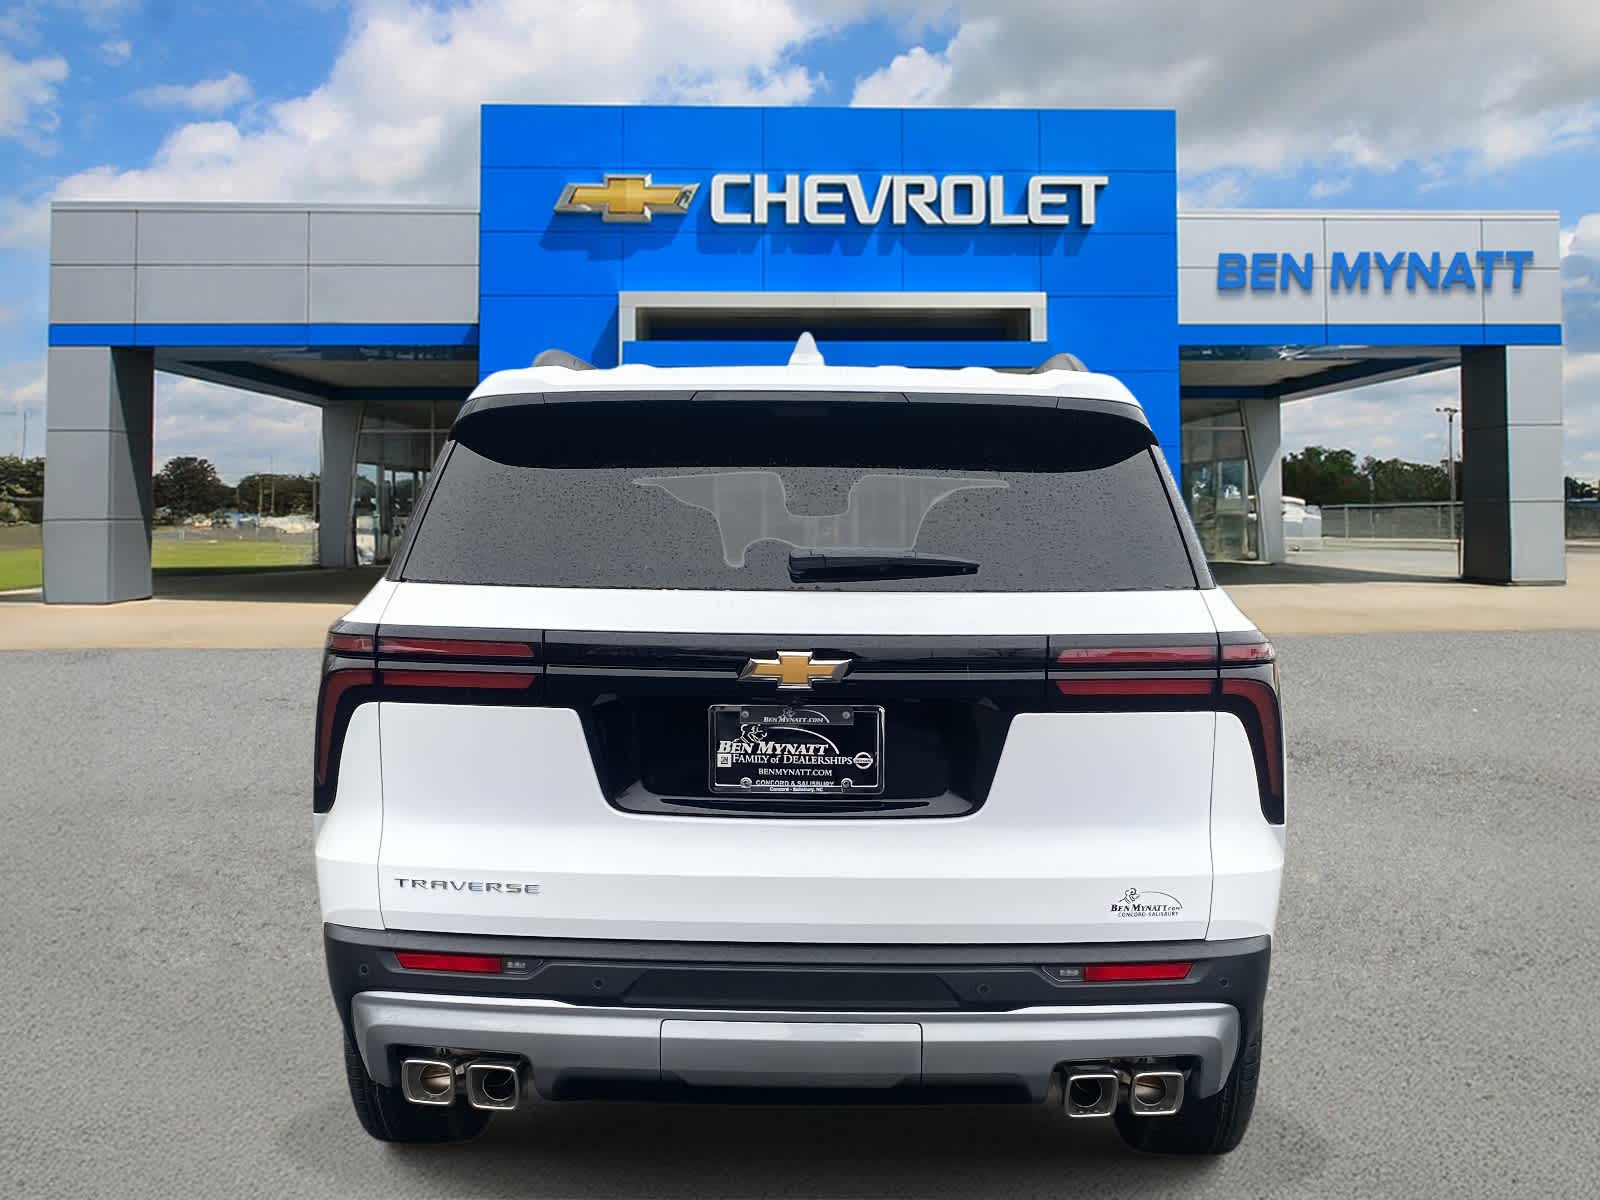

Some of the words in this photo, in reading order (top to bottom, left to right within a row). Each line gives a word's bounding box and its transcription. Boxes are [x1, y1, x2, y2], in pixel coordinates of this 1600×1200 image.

[710, 173, 1109, 225] CHEVROLET
[1217, 252, 1313, 290] BEN
[1330, 250, 1534, 290] MYNATT
[717, 740, 755, 754] BEN
[757, 741, 829, 755] MYNATT
[732, 754, 769, 764] FAMILY
[770, 755, 782, 764] of
[783, 754, 853, 765] DEALERSHIPS
[758, 768, 832, 776] BENMYNATT.COM
[394, 878, 542, 895] TRAVERSE
[1111, 904, 1129, 912] BEN
